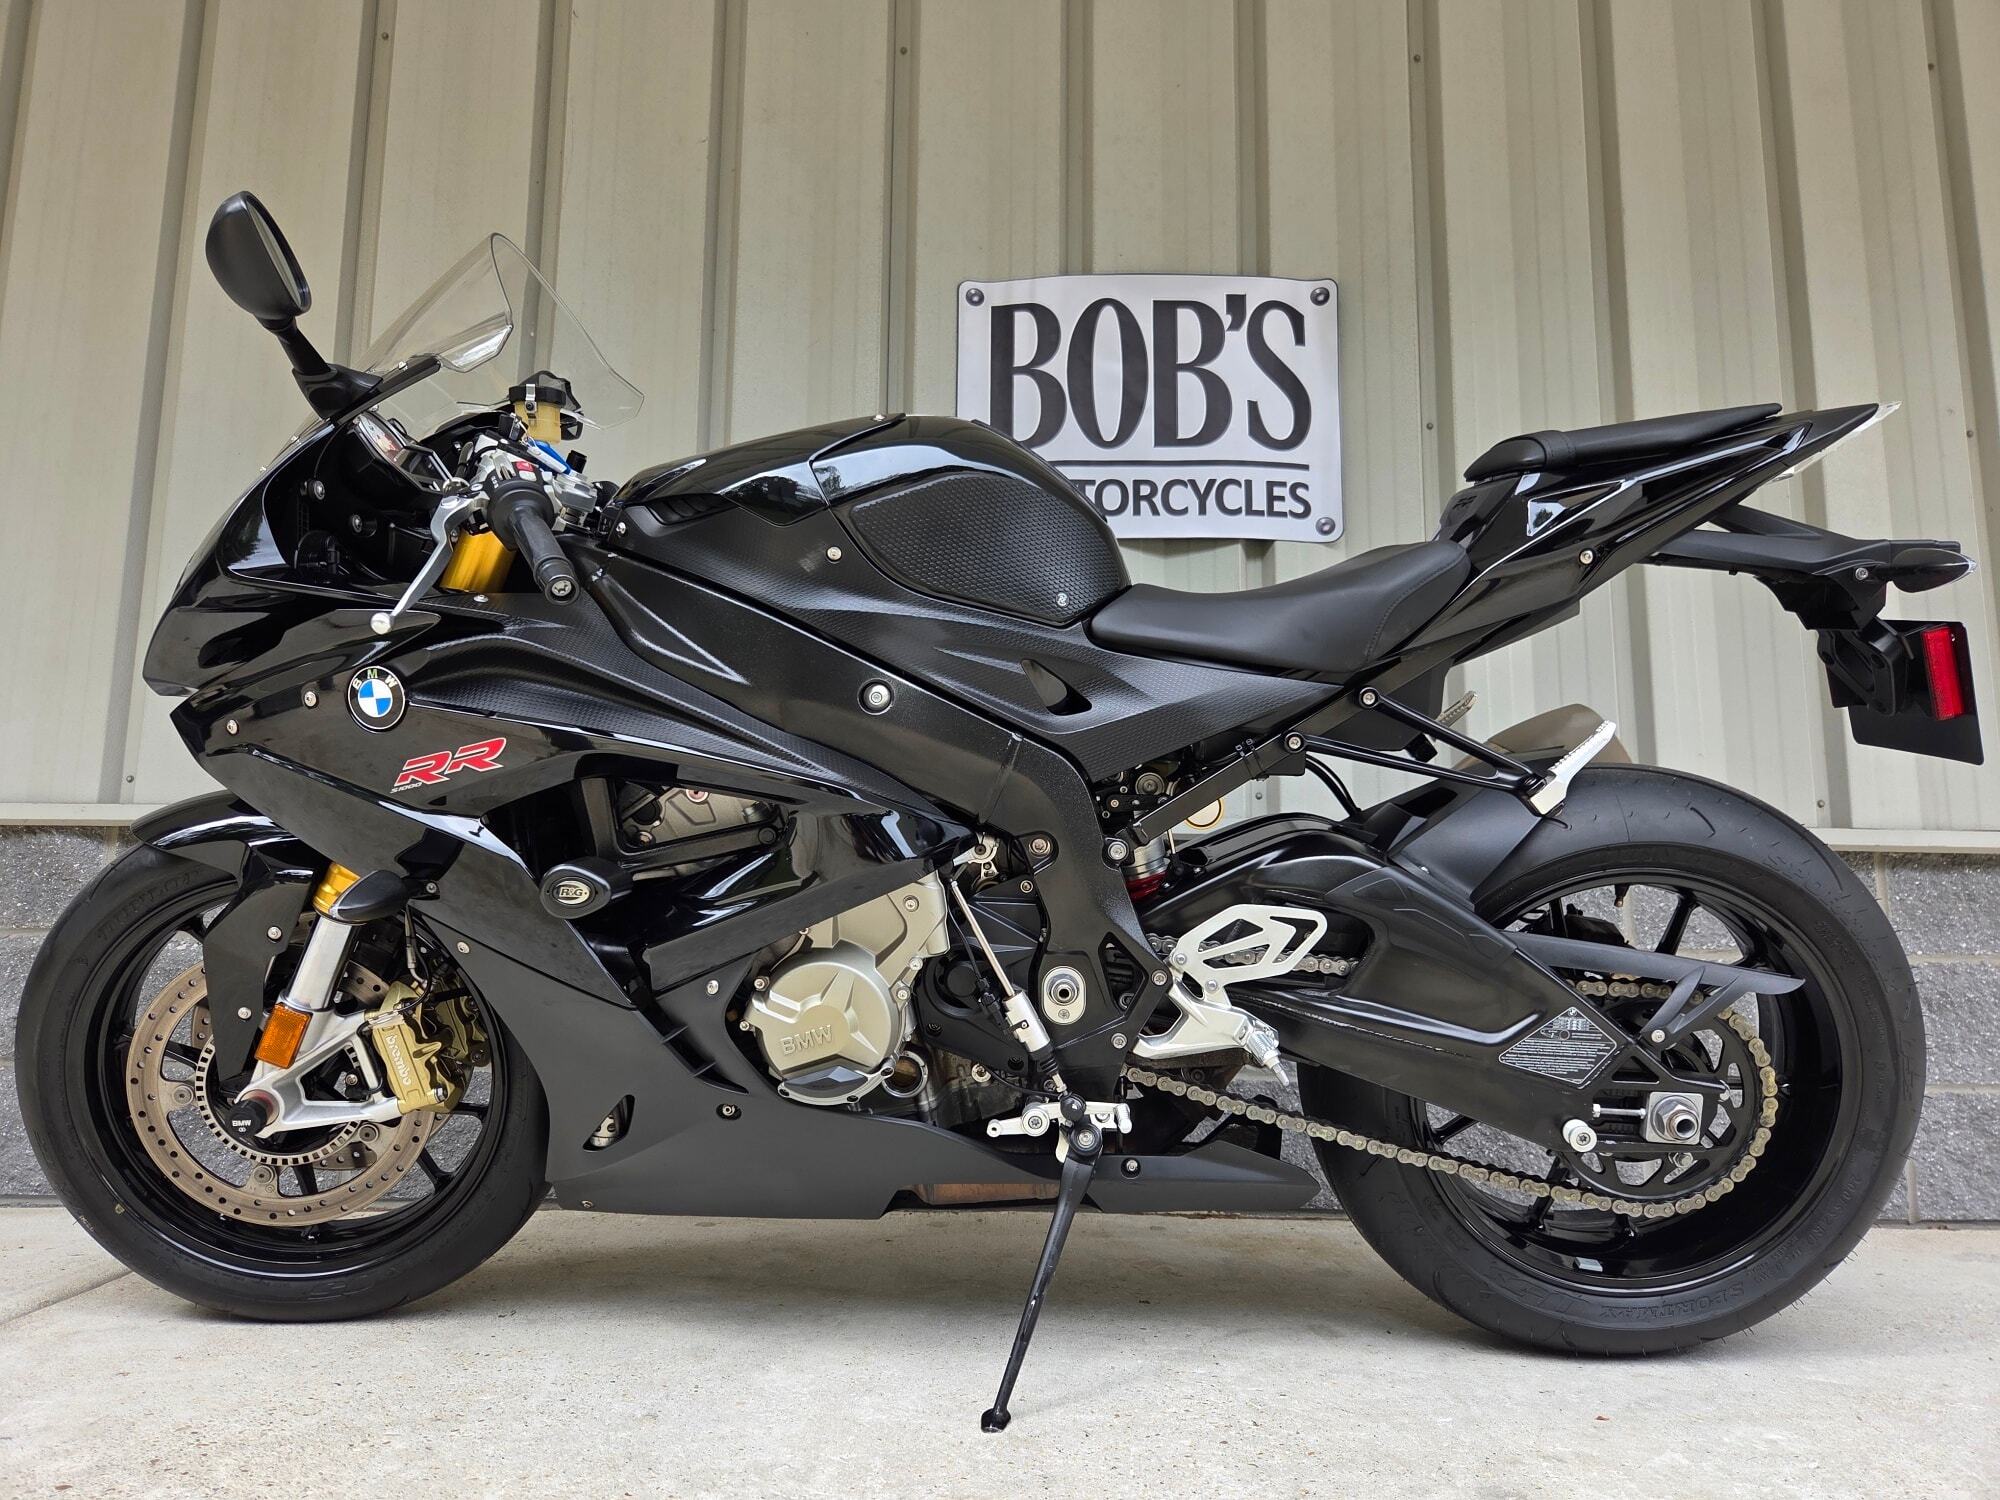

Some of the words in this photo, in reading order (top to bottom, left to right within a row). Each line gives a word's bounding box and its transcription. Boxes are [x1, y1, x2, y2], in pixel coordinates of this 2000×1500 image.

[990, 293, 1312, 451] BOB'S
[1069, 477, 1313, 520] TORCYCLES
[351, 667, 398, 691] BMW
[394, 737, 507, 785] RR
[560, 888, 584, 897] R&G
[780, 1024, 833, 1056] BMW
[385, 1034, 412, 1086] brembo
[231, 1119, 252, 1127] BMW
